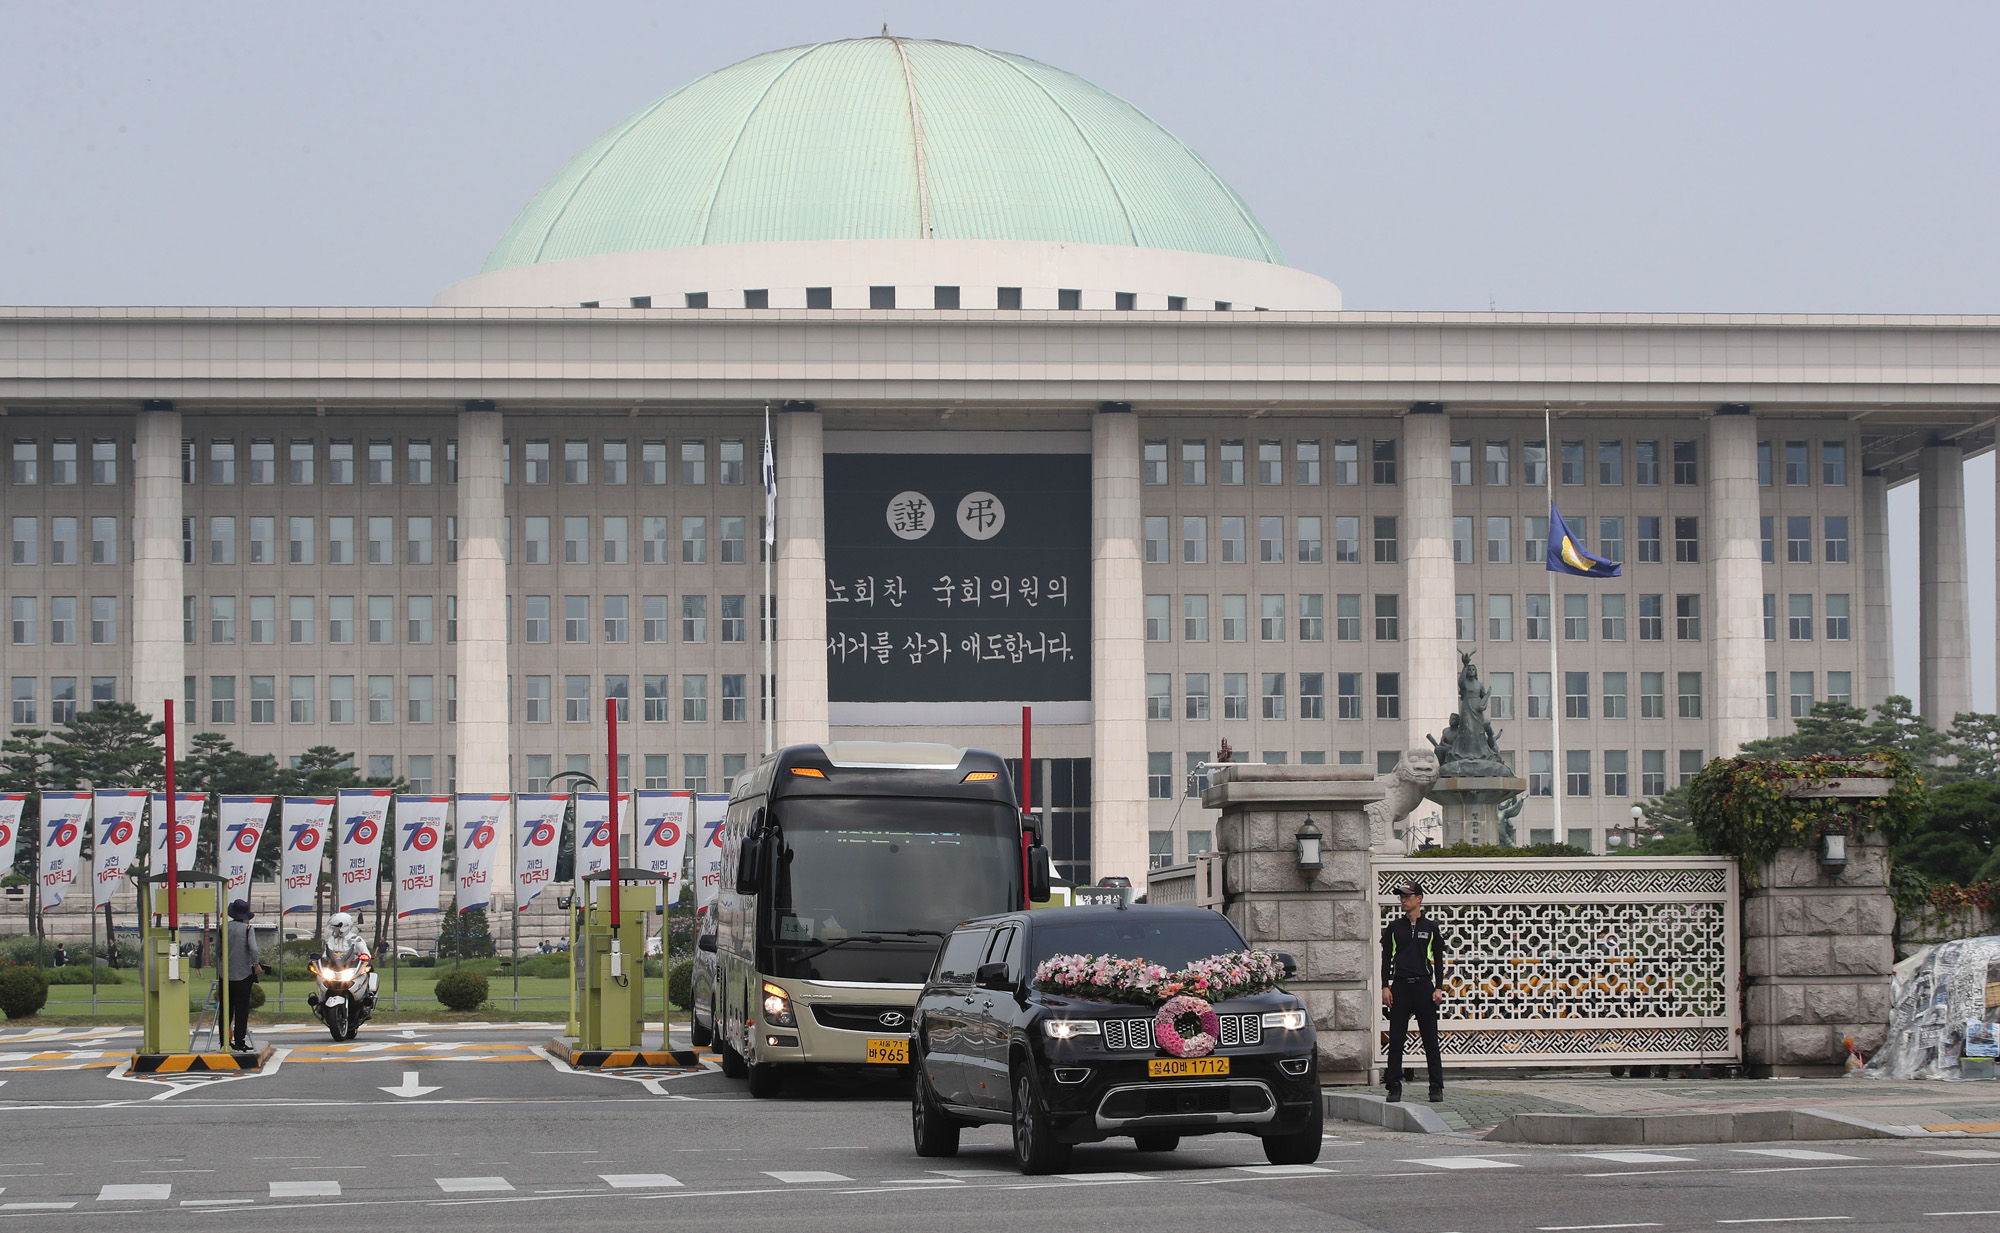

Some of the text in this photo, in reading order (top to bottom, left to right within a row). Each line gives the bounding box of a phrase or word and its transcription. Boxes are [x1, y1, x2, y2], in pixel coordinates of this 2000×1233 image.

[825, 575, 1068, 608] 노회찬 국회의원의
[826, 631, 1074, 664] 서거를 삼가 애도합니다.
[226, 823, 259, 853] 70
[288, 824, 319, 851] 70
[343, 816, 378, 845] 70
[403, 822, 438, 851] 70
[523, 819, 555, 847] 70
[644, 817, 680, 847] 70
[291, 864, 306, 875] 제헌
[349, 858, 365, 869] 제헌
[409, 864, 425, 876] 제헌
[527, 859, 542, 870] 제헌
[651, 860, 667, 870] 제헌
[285, 873, 312, 890] 70주년
[342, 868, 372, 884] 70주년
[401, 875, 433, 891] 70주년
[520, 868, 549, 885] 70주년
[880, 1049, 910, 1061] 965
[1192, 1060, 1225, 1073] 1712
